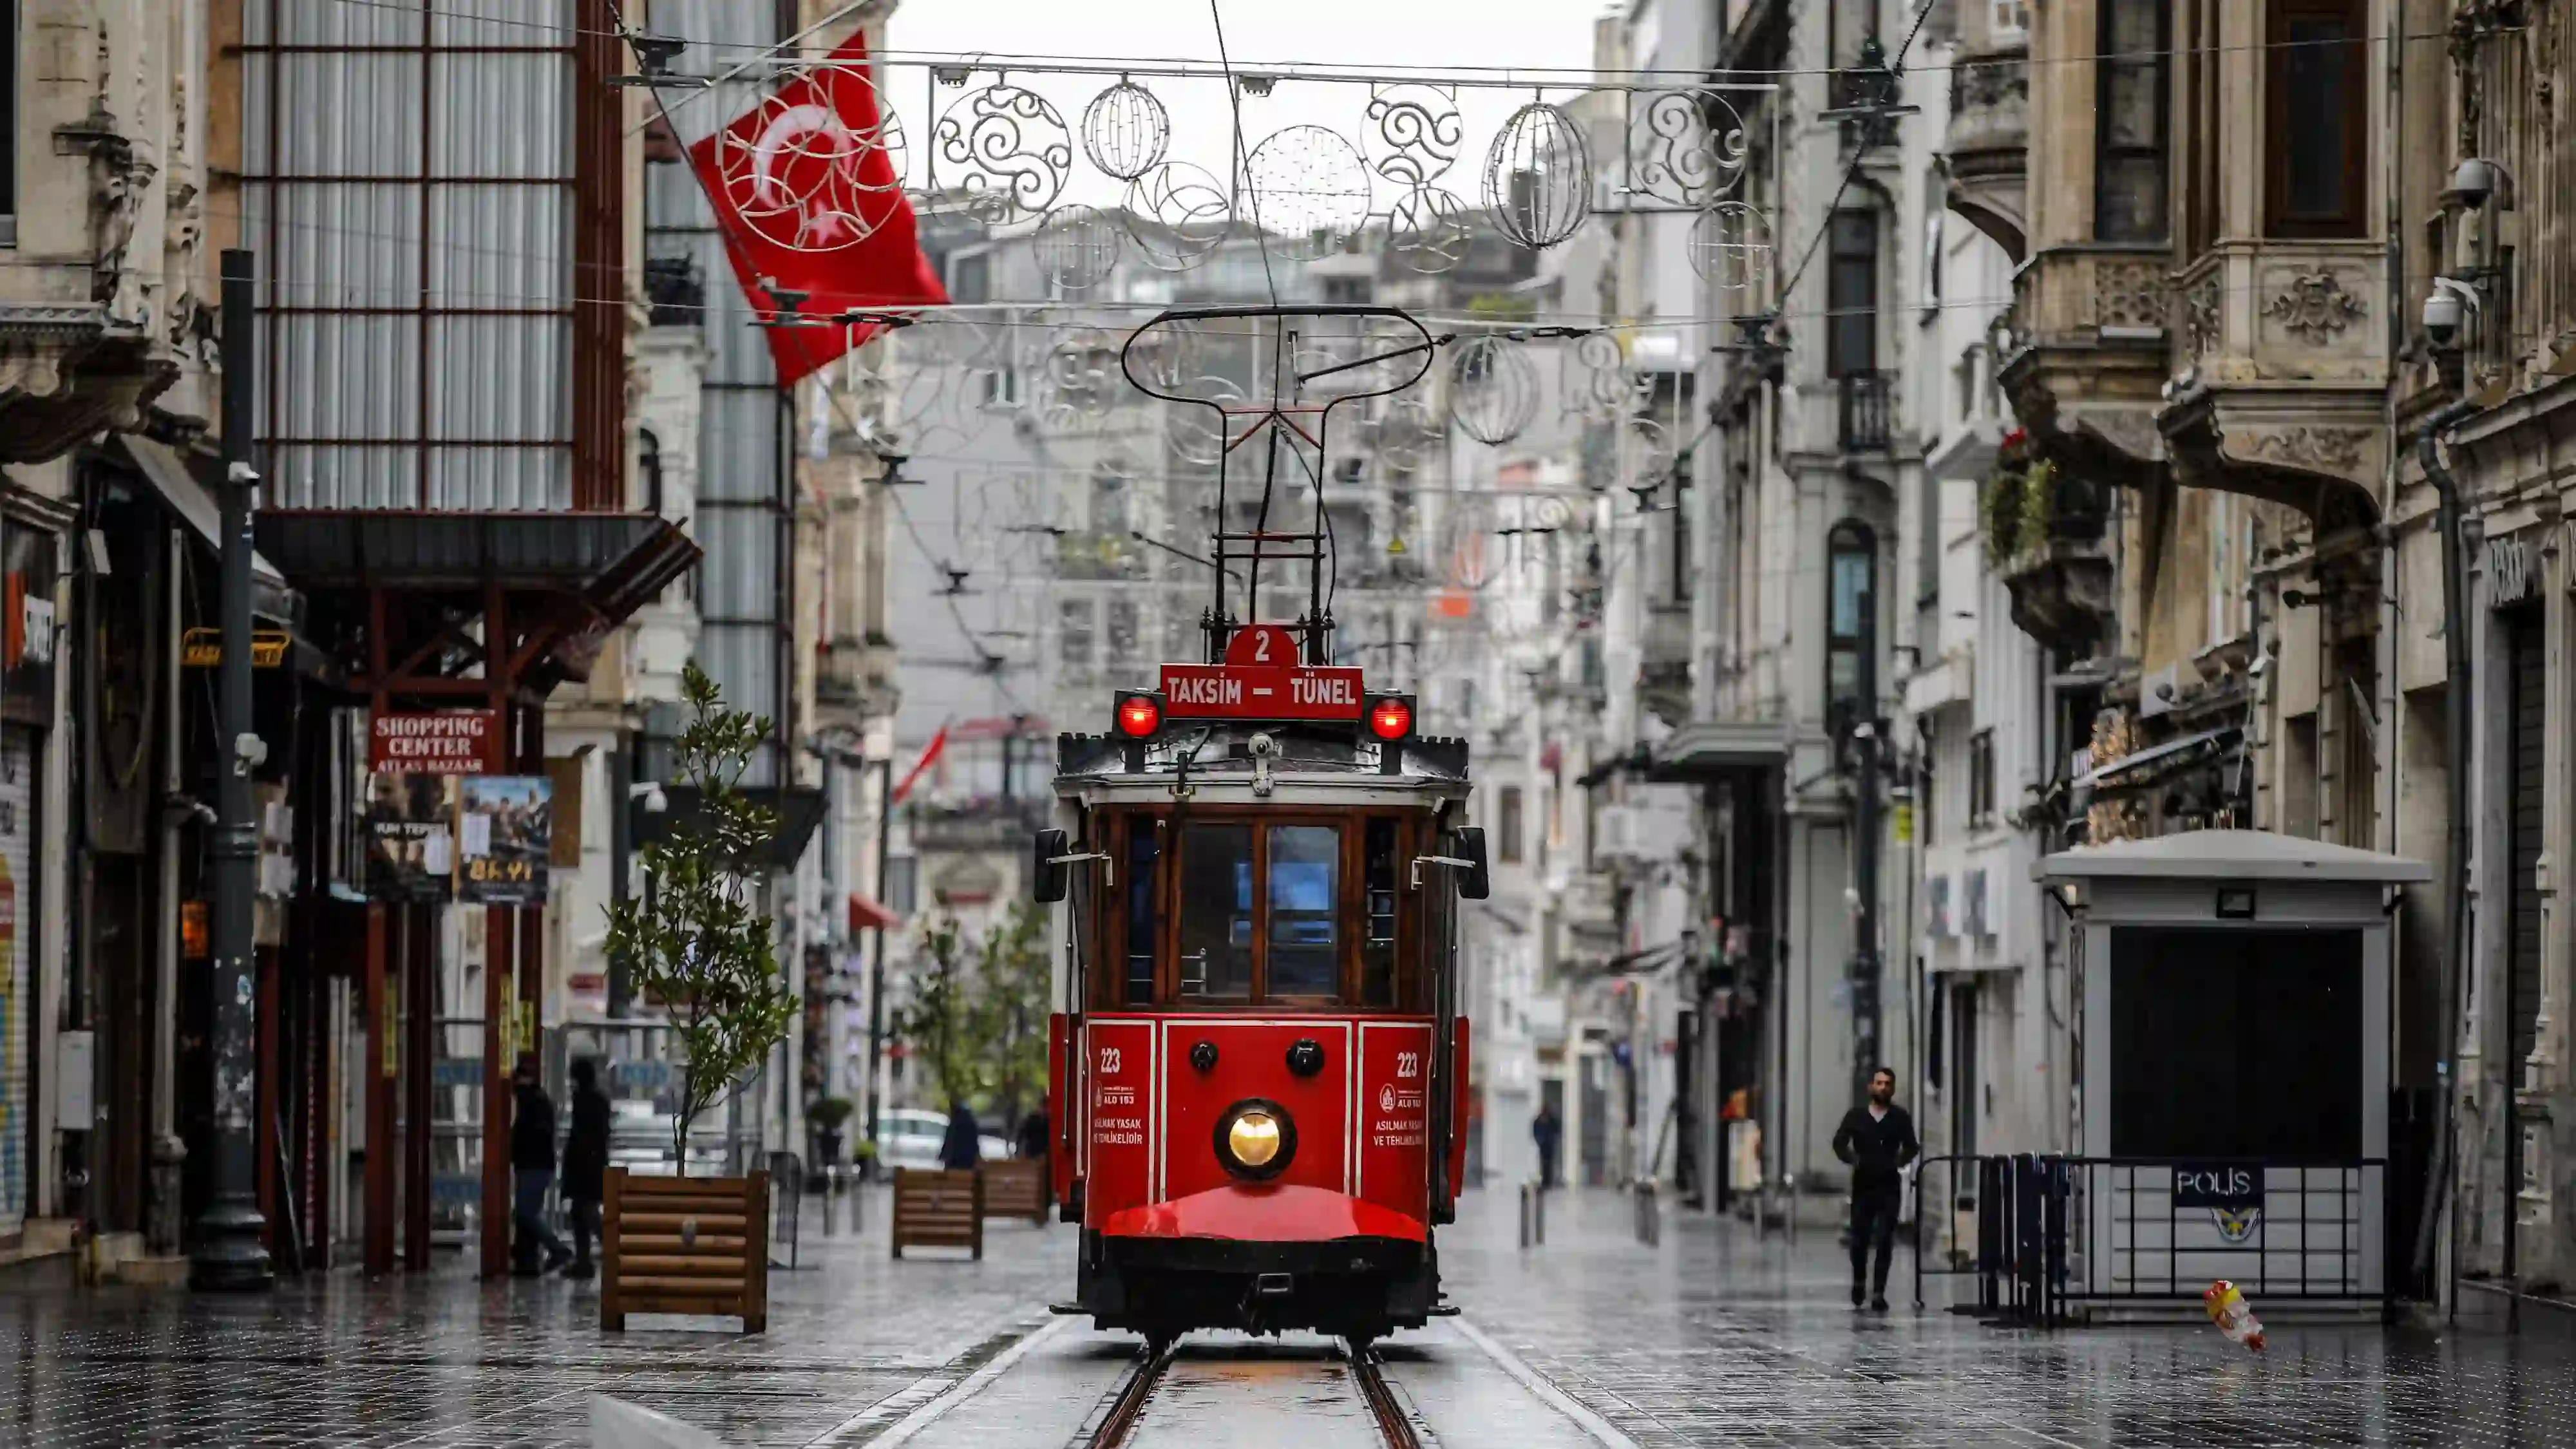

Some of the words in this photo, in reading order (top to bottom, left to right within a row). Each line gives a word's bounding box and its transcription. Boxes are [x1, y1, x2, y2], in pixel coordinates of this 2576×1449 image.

[1255, 630, 1270, 661] 2
[1167, 672, 1242, 705] TAKSİM
[1290, 671, 1356, 705] TÜNEL
[376, 716, 484, 737] SHOPPING
[388, 737, 471, 756] CENTER
[1101, 1048, 1121, 1073] 223
[1397, 1052, 1417, 1077] 223
[1104, 1095, 1117, 1105] ALO
[1397, 1099, 1412, 1108] ALO
[1117, 1119, 1141, 1129] YASAK
[1376, 1120, 1408, 1132] ASILMAK
[1373, 1135, 1384, 1146] VE
